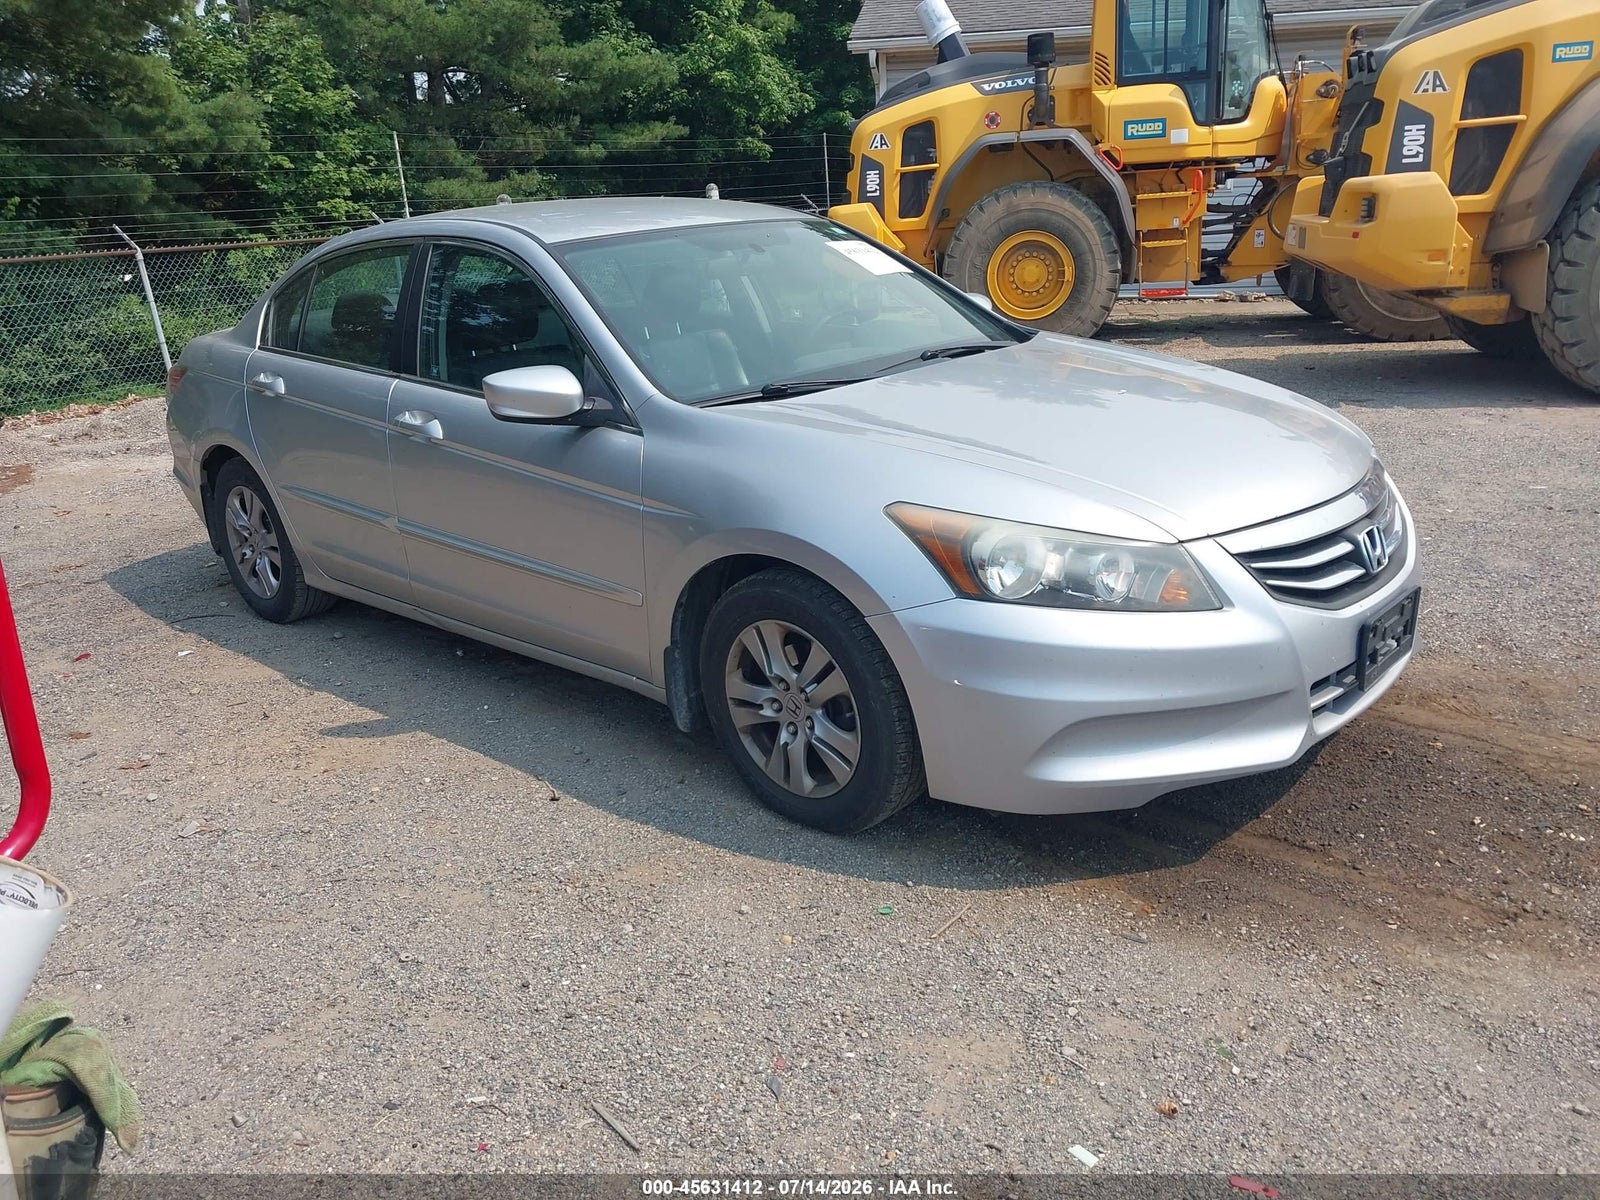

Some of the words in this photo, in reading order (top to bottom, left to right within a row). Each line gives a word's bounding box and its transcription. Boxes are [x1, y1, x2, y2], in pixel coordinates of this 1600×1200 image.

[1556, 45, 1590, 59] RUDD
[1127, 122, 1163, 136] RUDD
[1401, 124, 1426, 164] L90H
[866, 170, 880, 197] L90H
